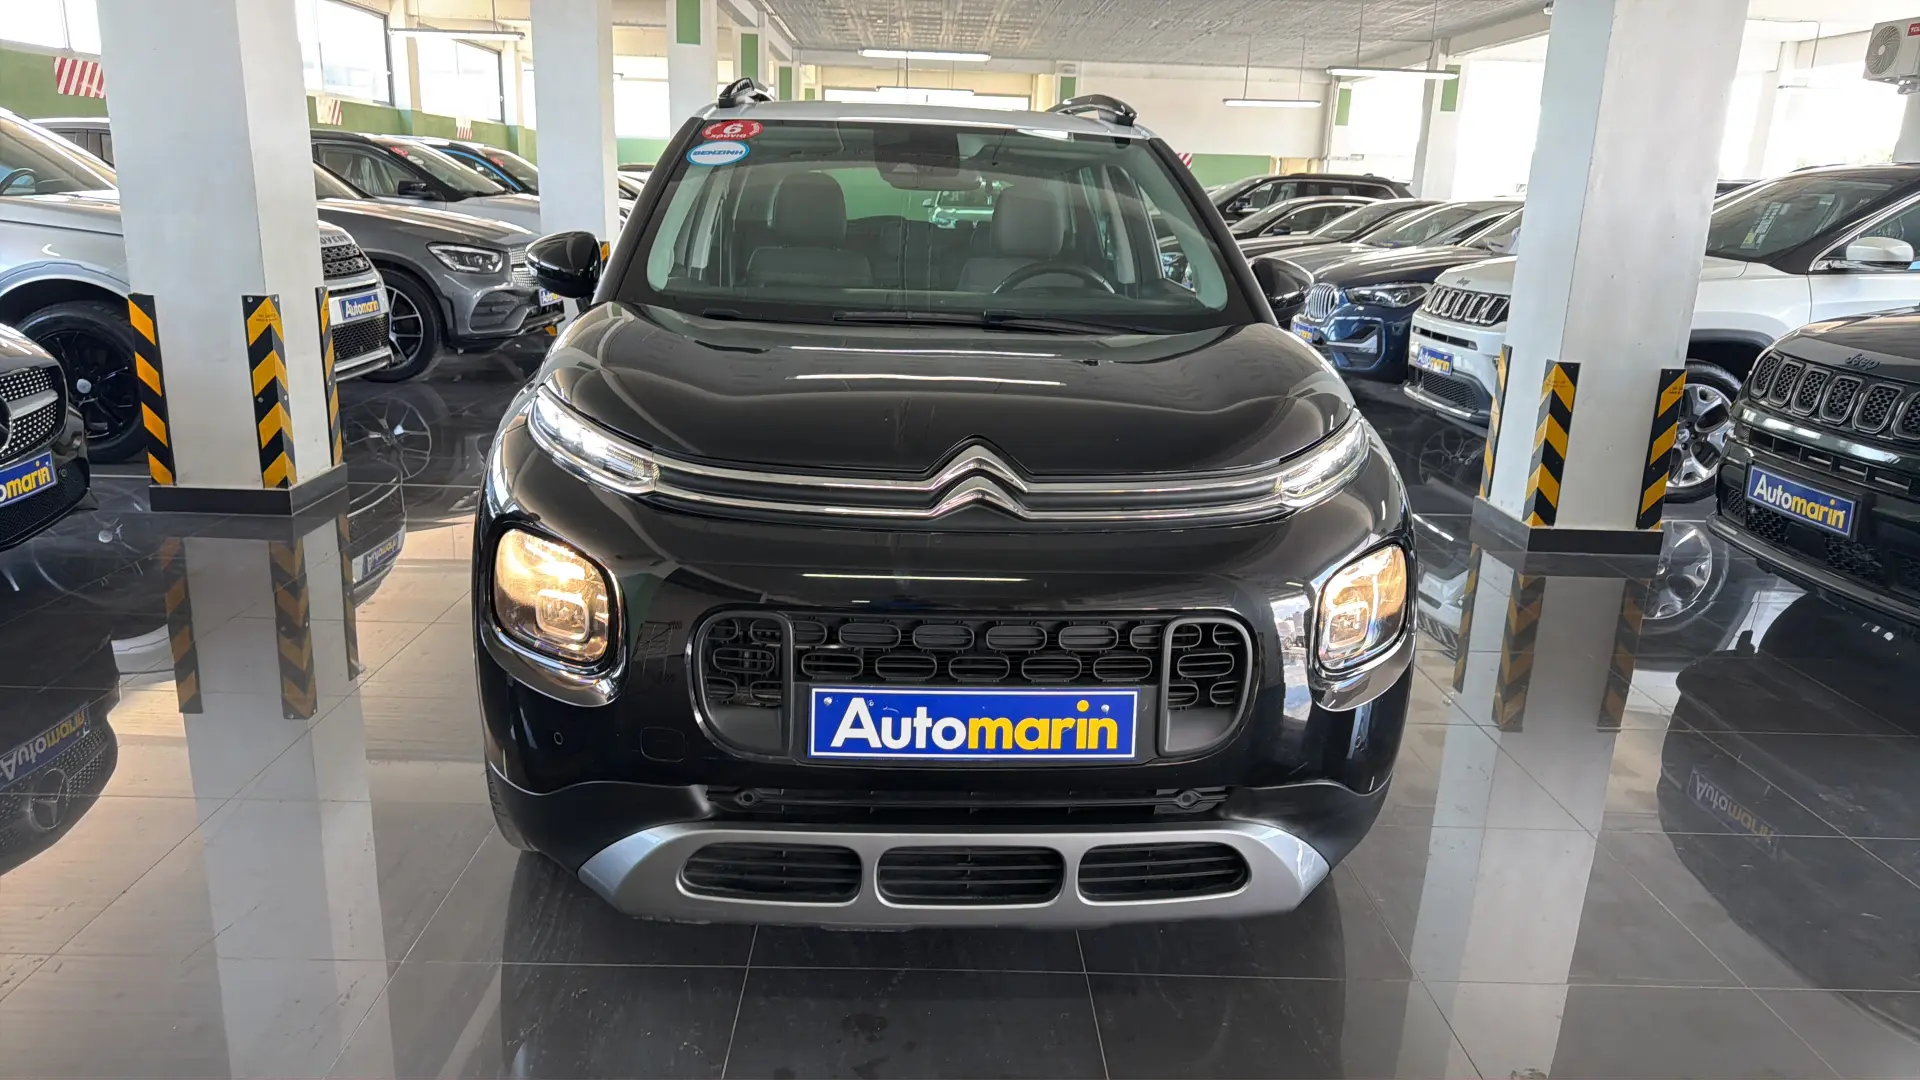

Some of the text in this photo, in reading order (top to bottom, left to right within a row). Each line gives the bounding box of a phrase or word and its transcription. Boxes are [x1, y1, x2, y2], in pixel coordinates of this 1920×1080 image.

[723, 123, 743, 134] 6
[345, 295, 379, 318] Automarin
[1845, 353, 1880, 370] Jeep
[0, 460, 51, 502] omarin
[1753, 474, 1846, 529] Automarin
[830, 697, 1118, 750] Automarin
